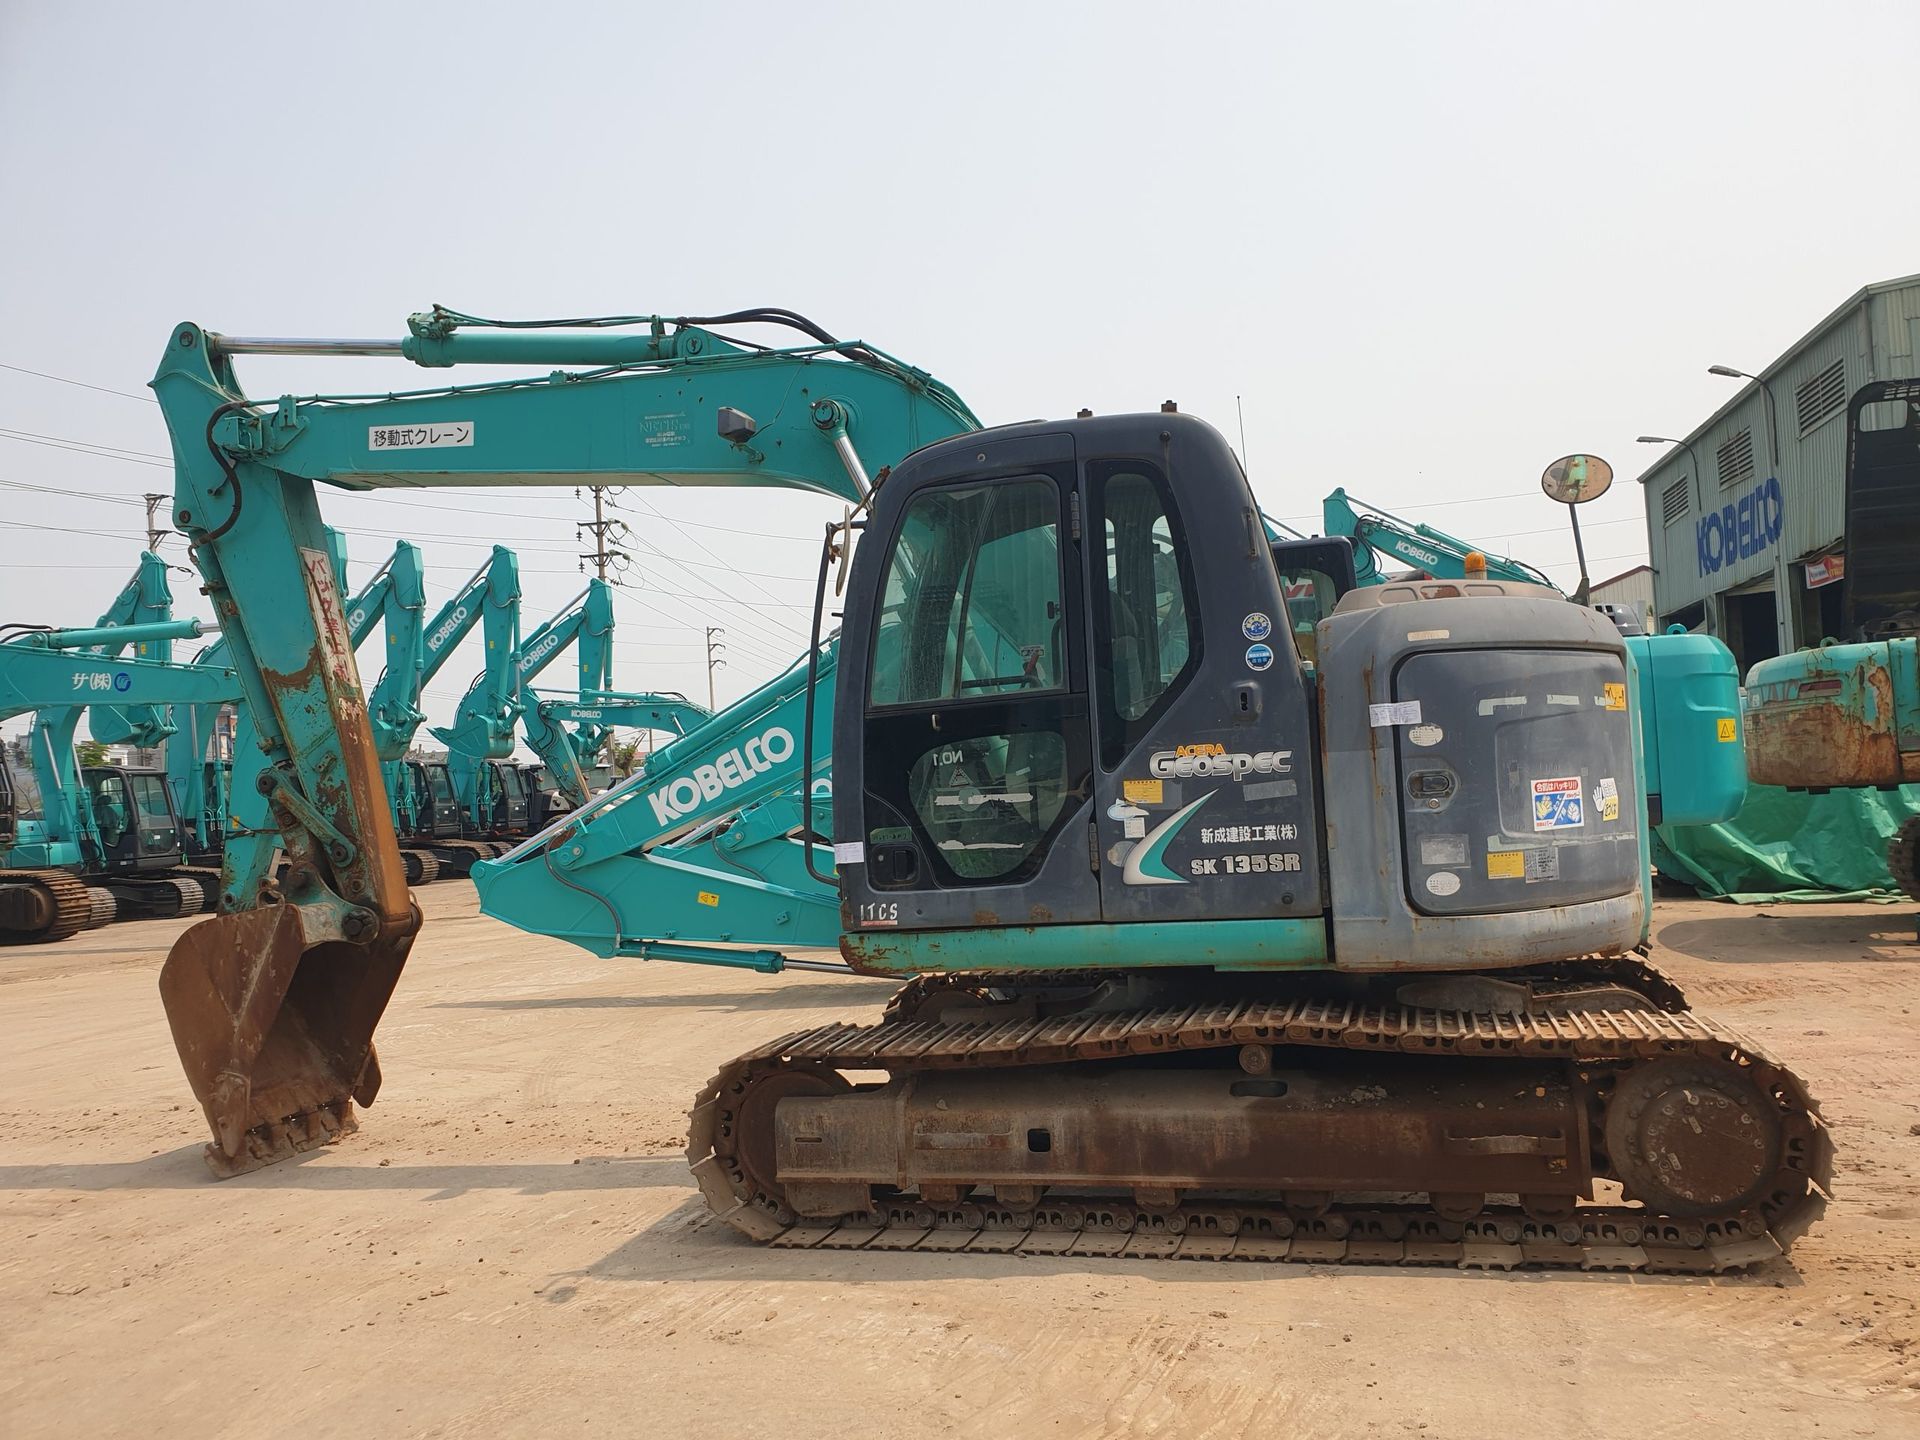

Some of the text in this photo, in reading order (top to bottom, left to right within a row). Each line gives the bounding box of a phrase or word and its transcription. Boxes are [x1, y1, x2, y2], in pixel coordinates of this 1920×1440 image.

[374, 427, 469, 447] 移動式クレーン
[1696, 477, 1783, 578] KOBELCO
[1395, 540, 1438, 566] KOBELCO
[427, 606, 467, 652] KOBELCO
[518, 634, 558, 672] KOBELCO
[571, 709, 602, 718] KOBELCO
[1175, 743, 1226, 757] ACERA
[647, 726, 795, 827] KOBELCO
[1201, 824, 1298, 844] 新成建設工業(株)
[1191, 853, 1301, 875] SK 135SR
[860, 902, 898, 921] ITCS
